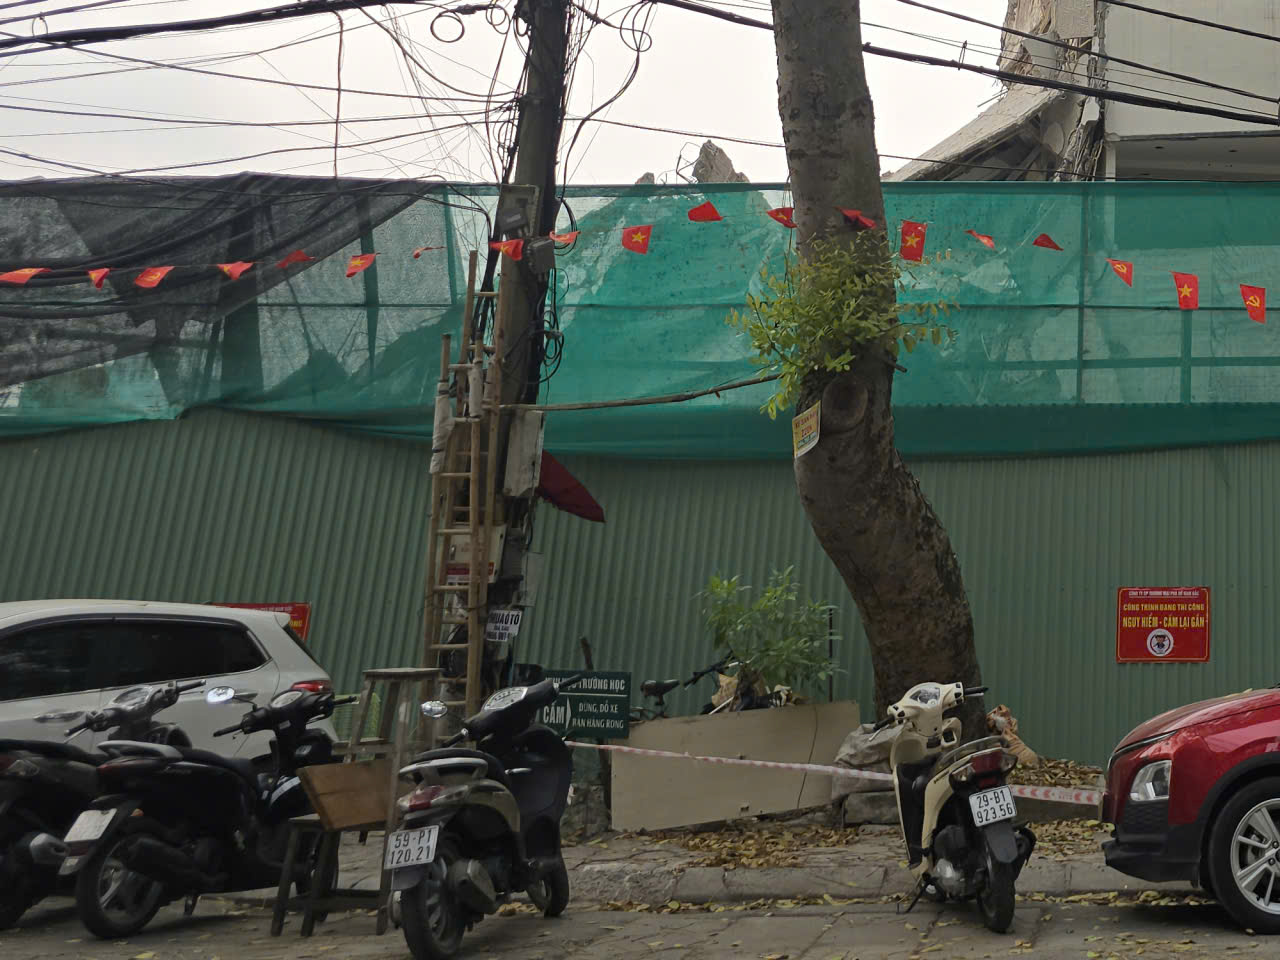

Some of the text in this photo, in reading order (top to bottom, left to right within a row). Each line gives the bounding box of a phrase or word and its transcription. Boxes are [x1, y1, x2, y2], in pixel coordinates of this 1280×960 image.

[1123, 603, 1140, 611] CÔNG
[1177, 603, 1187, 611] THI
[1188, 603, 1205, 611] CÔNG
[1122, 616, 1140, 628] NGUY
[1163, 613, 1178, 628] CẤM
[1179, 616, 1189, 629] LẠI
[609, 679, 625, 692] HỌC
[543, 700, 565, 724] CẤM
[610, 704, 618, 713] XE
[976, 790, 1006, 809] 29-B1
[976, 802, 1013, 823] 923.56
[394, 829, 432, 849] 59-P1
[391, 845, 431, 864] 120.21
